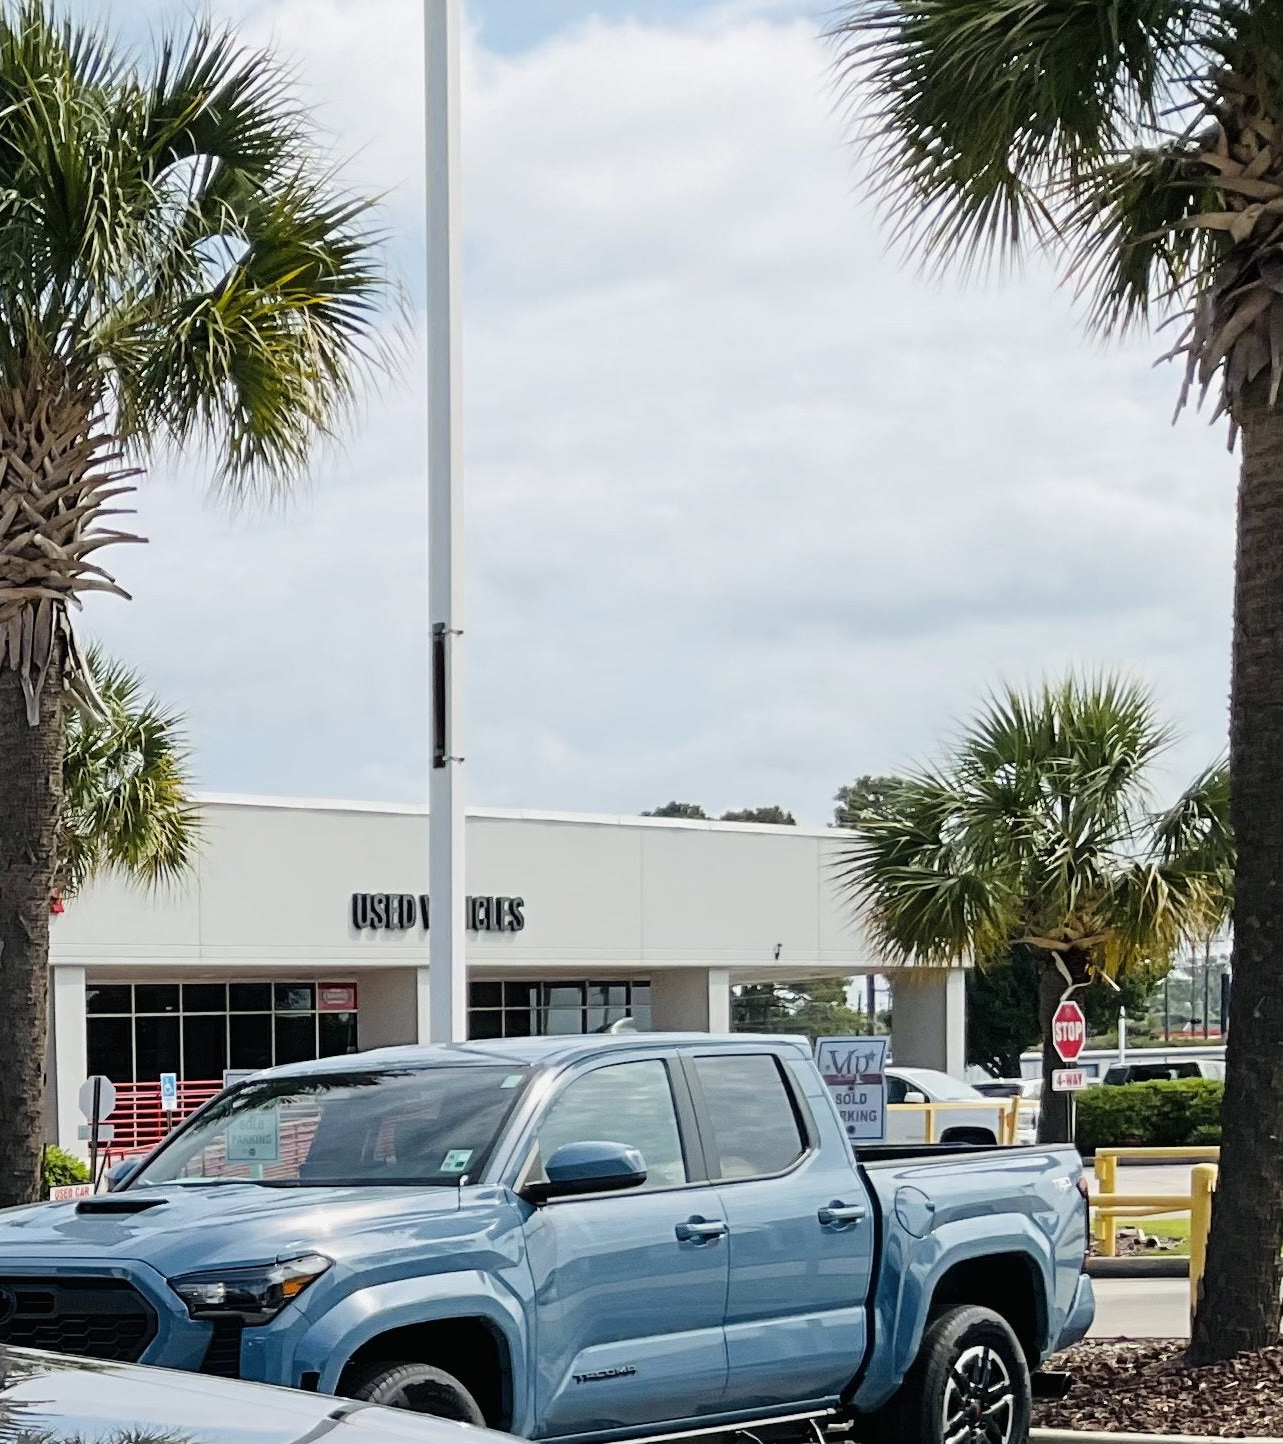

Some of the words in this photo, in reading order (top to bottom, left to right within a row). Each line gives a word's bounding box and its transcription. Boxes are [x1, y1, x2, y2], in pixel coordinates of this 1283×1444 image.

[352, 893, 416, 930] USED
[1055, 1021, 1082, 1042] STOP
[1056, 1073, 1083, 1087] 4-WAY
[835, 1093, 867, 1105] SOLD
[840, 1110, 878, 1122] RKING
[54, 1188, 73, 1200] USED
[74, 1186, 90, 1198] CAR
